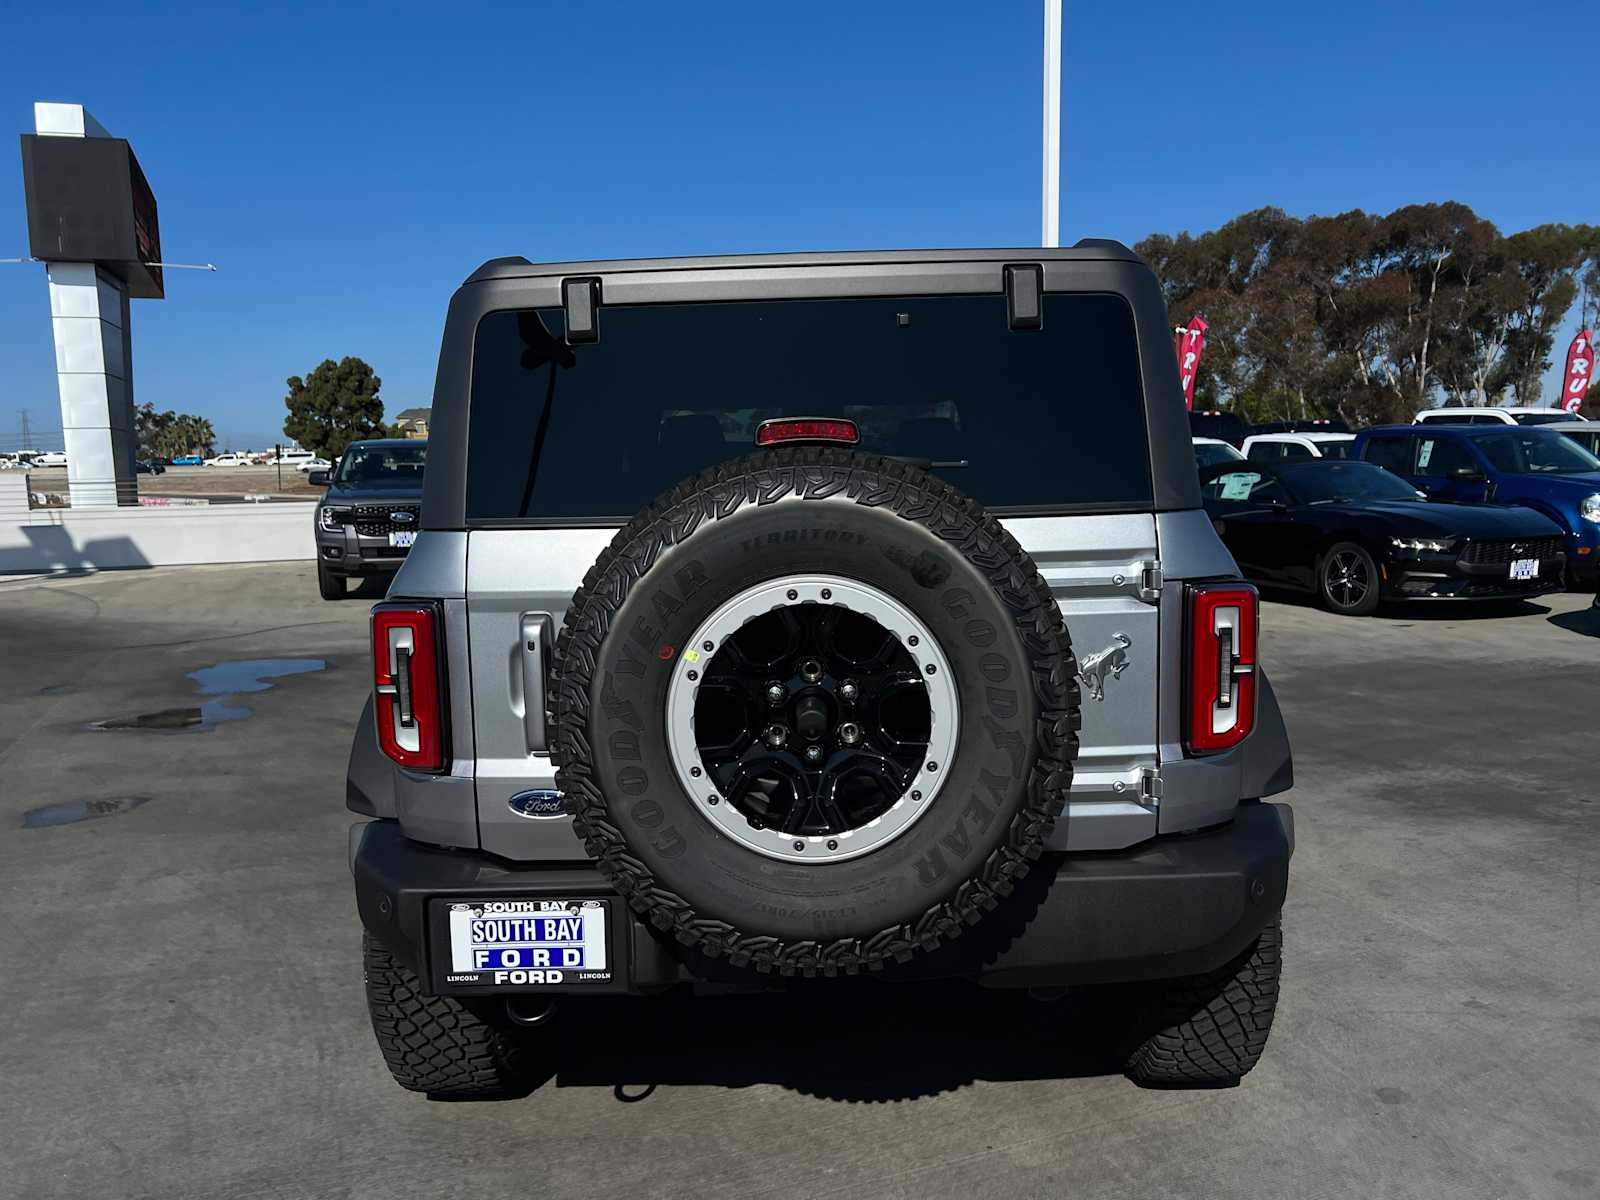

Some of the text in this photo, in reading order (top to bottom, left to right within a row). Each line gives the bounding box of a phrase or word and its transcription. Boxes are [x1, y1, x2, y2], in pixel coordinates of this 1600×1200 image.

[740, 527, 869, 550] TERRITORY
[524, 796, 561, 811] Ford
[483, 902, 534, 913] SOUTH
[540, 901, 569, 912] BAY
[472, 918, 581, 943] SOUTH BAY
[475, 949, 581, 969] FORD
[446, 974, 479, 982] LINCOLN
[494, 970, 564, 985] FORD
[579, 972, 611, 980] LINCOLN
